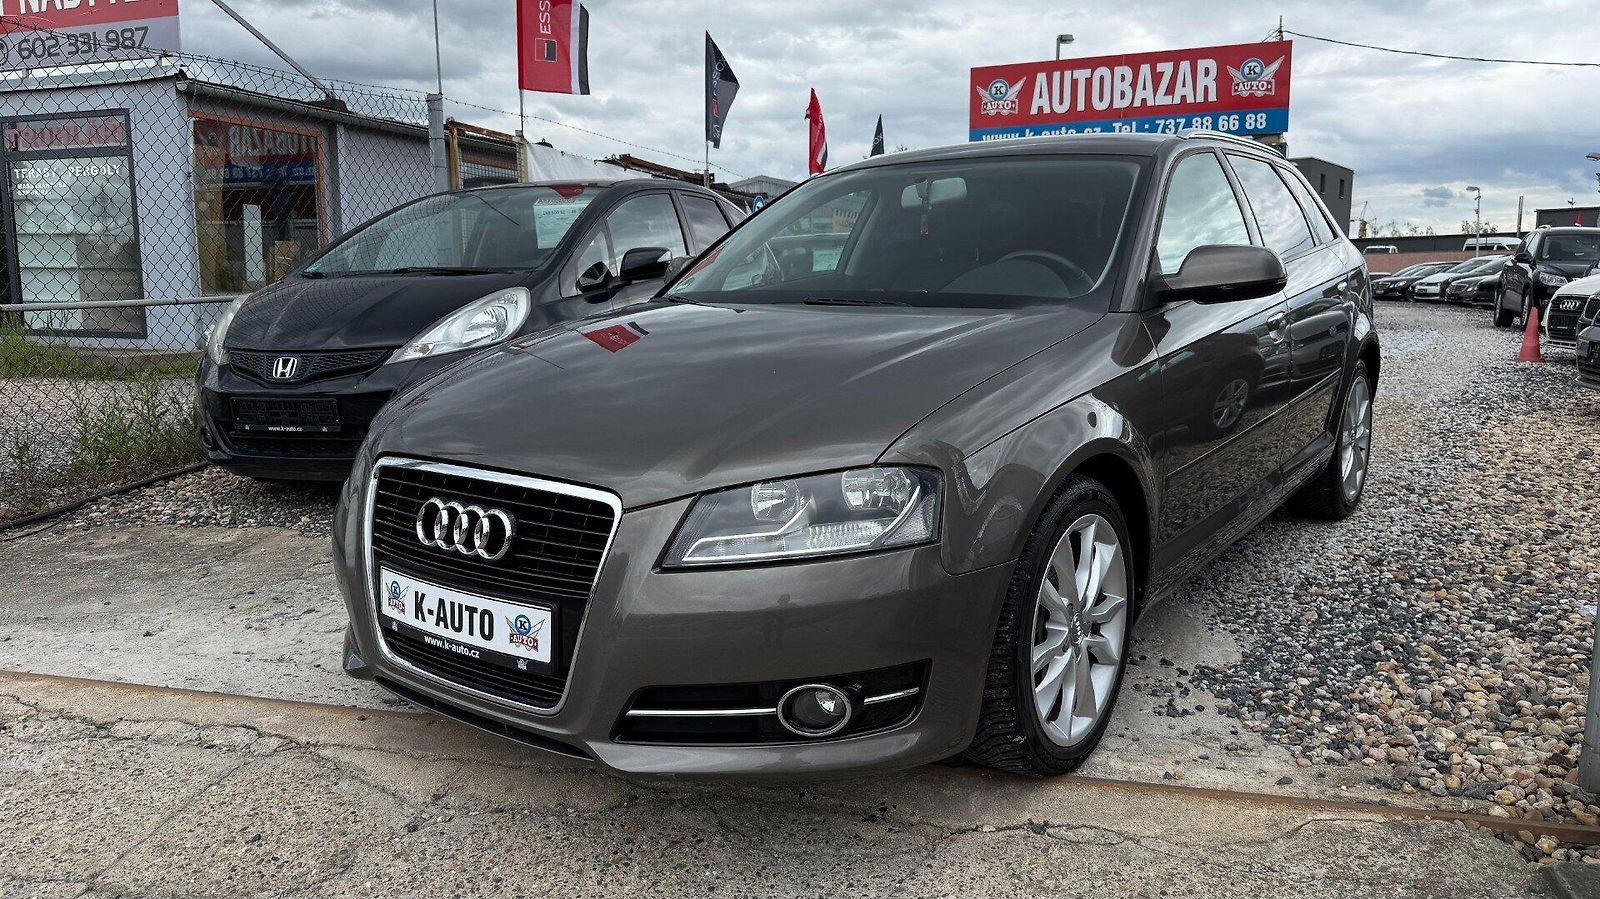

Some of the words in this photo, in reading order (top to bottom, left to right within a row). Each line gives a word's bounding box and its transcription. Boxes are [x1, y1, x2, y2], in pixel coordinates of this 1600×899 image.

[18, 35, 60, 60] 602
[67, 31, 97, 56] 331
[105, 26, 149, 52] 987
[1246, 65, 1259, 76] K
[993, 85, 1004, 96] K
[1030, 58, 1218, 116] AUTOBAZAR
[1237, 81, 1268, 91] AUTO
[986, 100, 1012, 110] AUTO
[1155, 118, 1186, 136] 737
[1192, 116, 1212, 131] 88
[1218, 114, 1239, 131] 66
[1245, 113, 1267, 130] 88
[68, 164, 121, 177] PERGOLY
[414, 590, 495, 641] K-AUTO
[518, 619, 528, 631] K
[424, 635, 480, 659] www.k-auto.cz
[512, 634, 534, 647] AUTO
